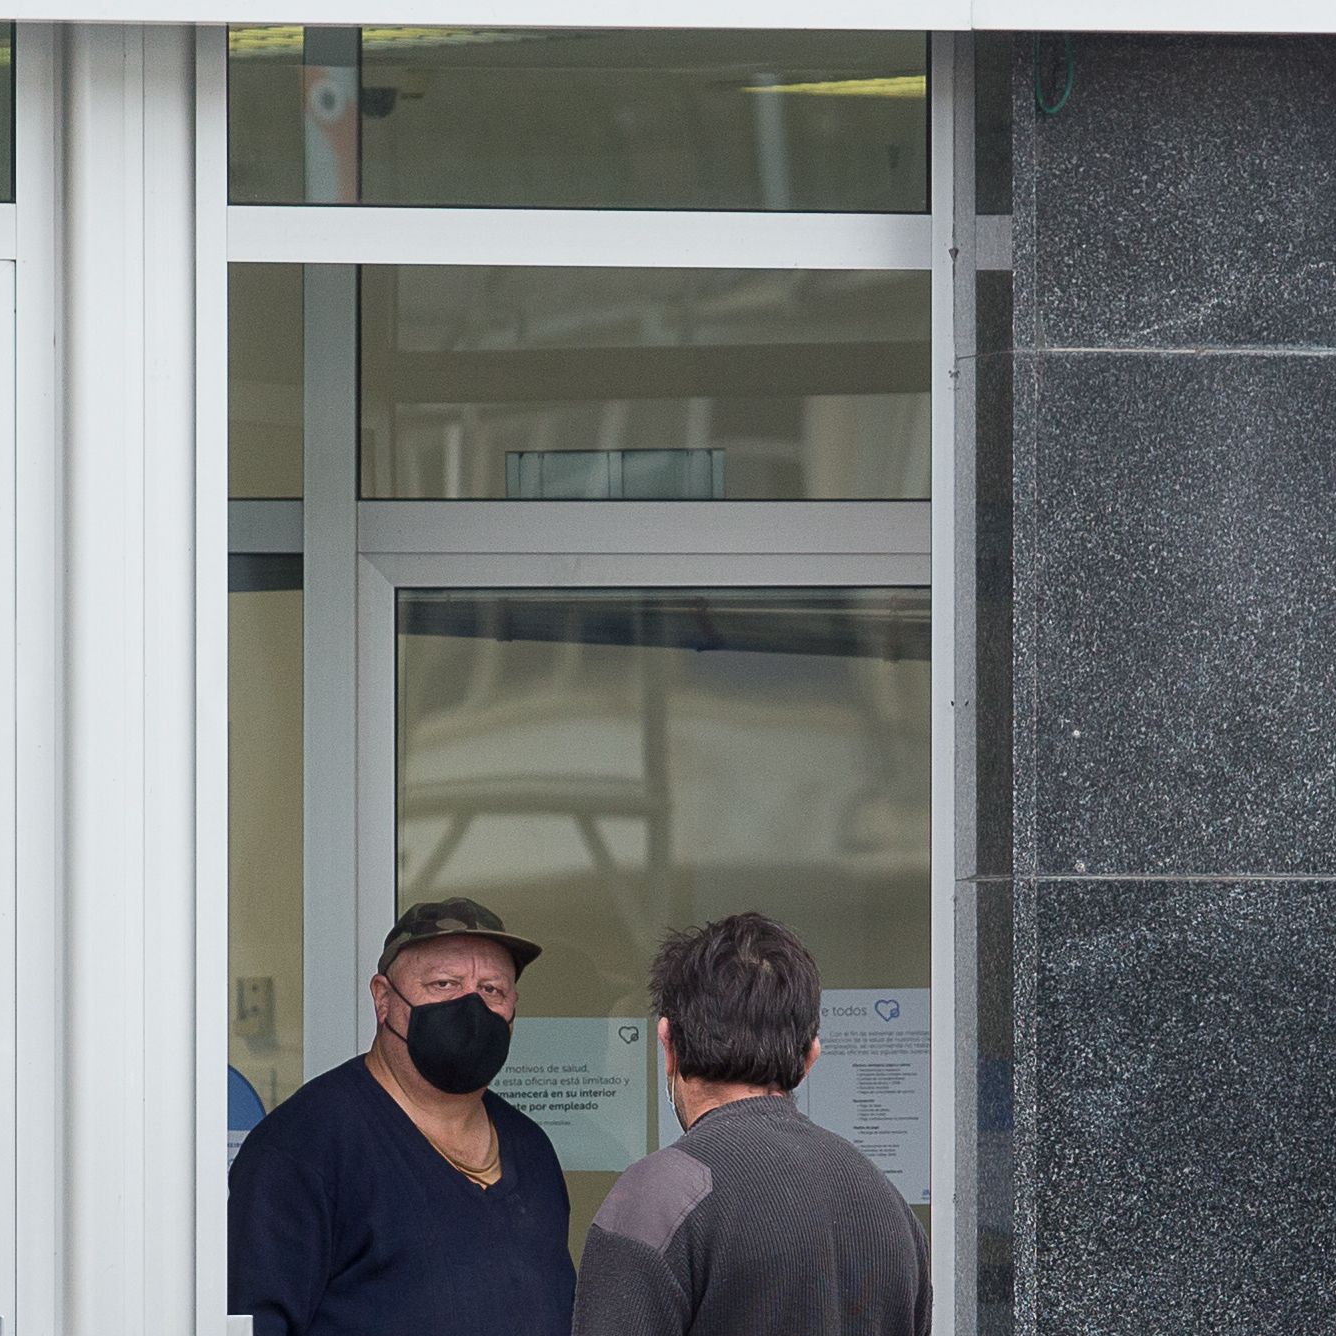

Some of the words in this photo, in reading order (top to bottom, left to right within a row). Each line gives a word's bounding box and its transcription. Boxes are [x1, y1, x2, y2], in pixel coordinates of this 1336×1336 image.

[832, 1005, 868, 1017] todos
[505, 1064, 544, 1073] motivos
[546, 1064, 559, 1073] de
[502, 1078, 522, 1086] esta
[524, 1077, 558, 1086] oficina
[560, 1077, 580, 1086] está
[582, 1076, 622, 1085] limitado
[624, 1077, 630, 1086] y
[551, 1090, 563, 1098] en
[566, 1090, 577, 1098] su
[579, 1089, 616, 1098] interior
[529, 1103, 546, 1112] por
[549, 1102, 599, 1112] empleado
